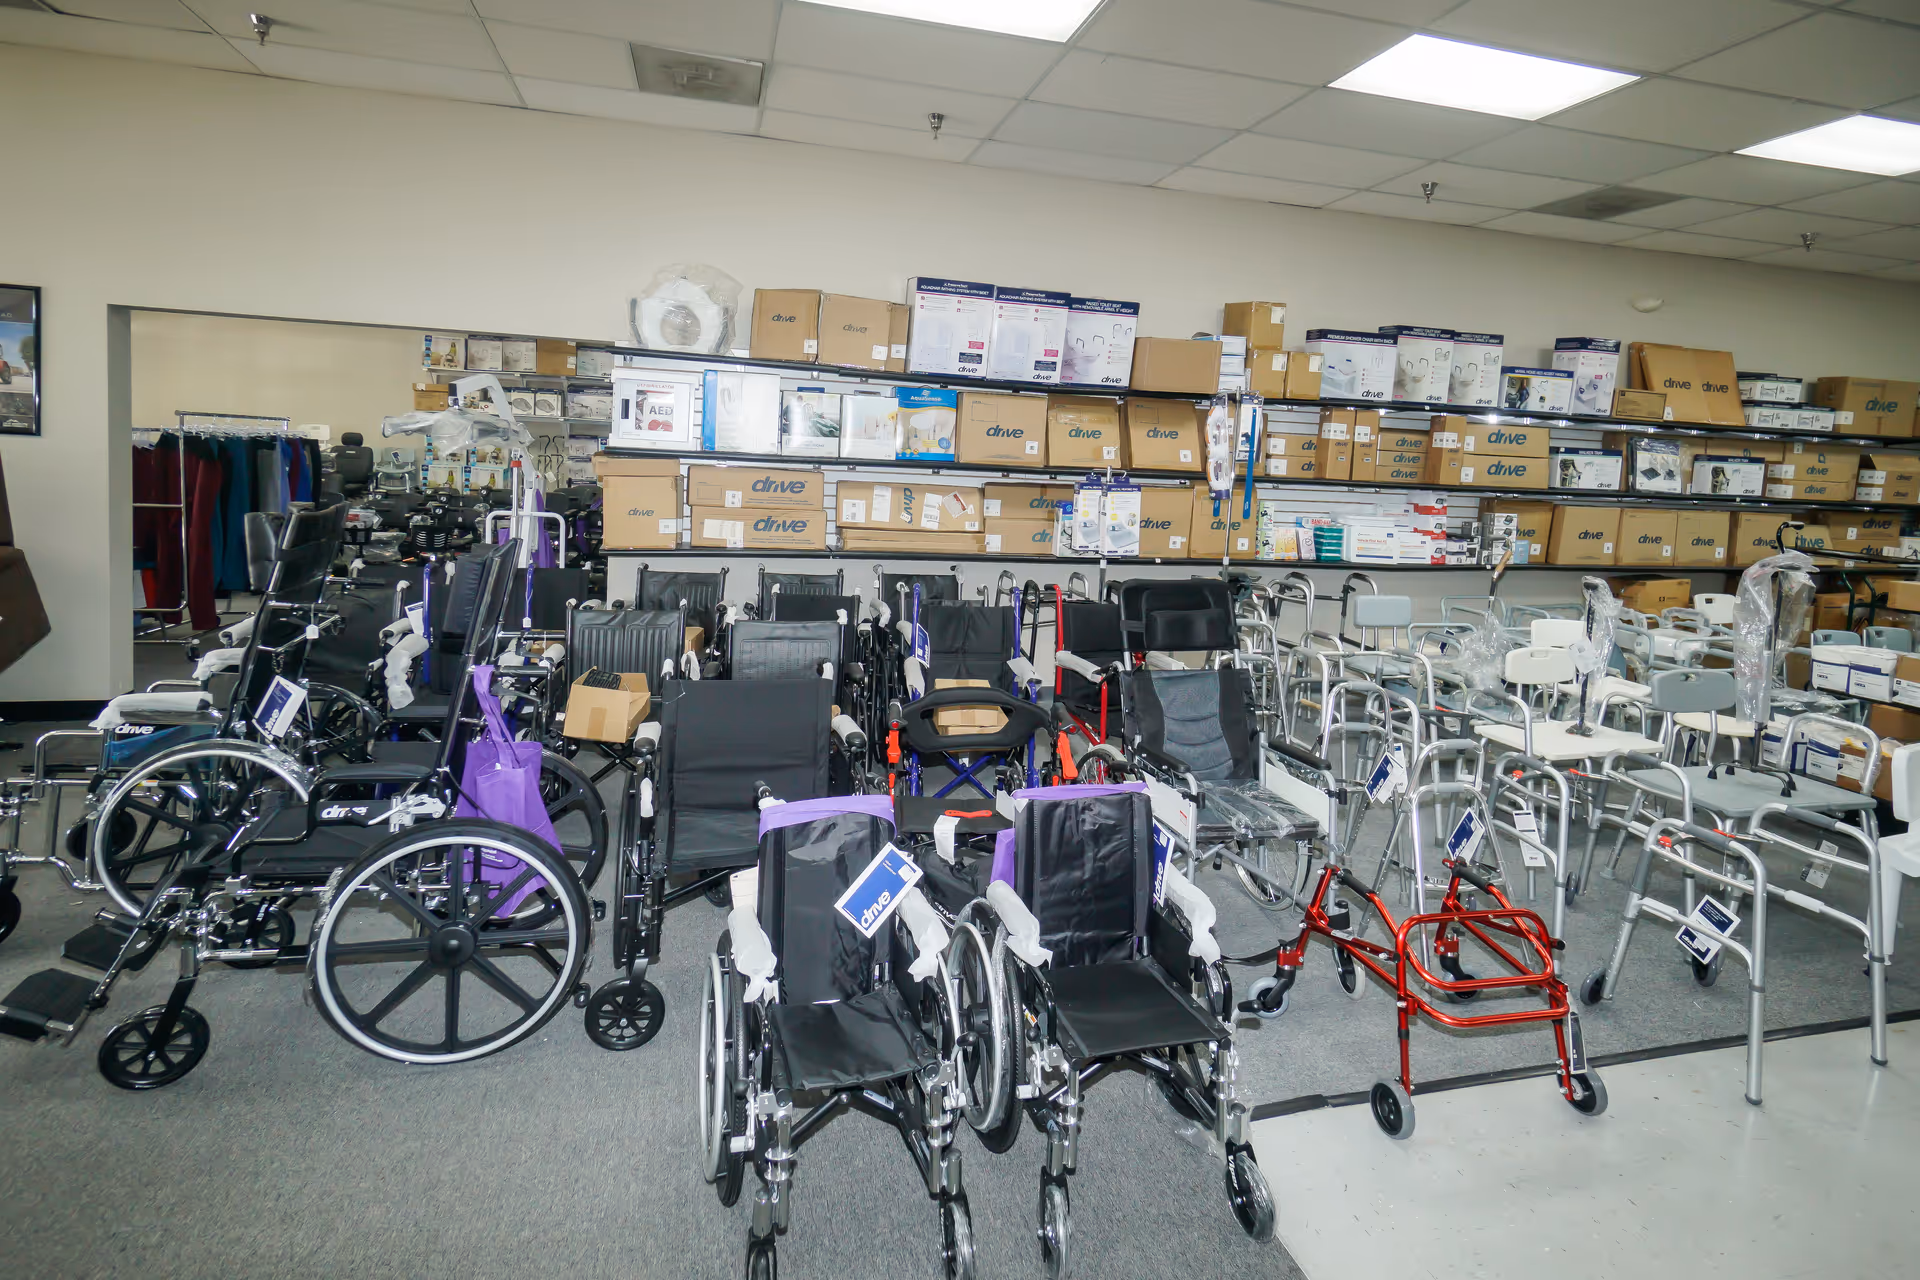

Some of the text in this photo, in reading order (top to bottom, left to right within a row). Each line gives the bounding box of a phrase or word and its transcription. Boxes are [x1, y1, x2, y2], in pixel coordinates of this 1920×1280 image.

[772, 313, 796, 323] drive
[843, 323, 868, 334] drive
[958, 365, 978, 374] drive
[1032, 373, 1052, 381] drive
[1101, 375, 1122, 385] drive
[1663, 377, 1691, 390] drive
[1702, 381, 1729, 393] drive
[1362, 389, 1384, 399] drive
[1426, 394, 1442, 402] drive
[649, 405, 673, 416] AED
[1865, 396, 1898, 413] drive
[986, 424, 1024, 439] drive
[1068, 426, 1102, 439] drive
[1146, 427, 1179, 440] drive
[1488, 429, 1527, 445] drive
[1396, 437, 1422, 448] drive
[1393, 453, 1421, 464] drive
[1391, 468, 1418, 479] drive
[1487, 460, 1526, 476] drive
[1806, 464, 1829, 476] drive
[751, 476, 806, 495] drive
[1804, 484, 1827, 495] drive
[628, 507, 655, 517] drive
[753, 516, 808, 534] drive
[1139, 517, 1172, 530] drive
[1863, 518, 1892, 529] drive
[1516, 528, 1536, 537] rive
[1578, 529, 1604, 541] drive
[1638, 533, 1663, 545] drive
[1691, 535, 1715, 547] drive
[1752, 536, 1777, 547] drive
[115, 723, 155, 735] drive
[1155, 860, 1164, 897] drive
[861, 890, 891, 929] drive
[1681, 934, 1699, 950] drive
